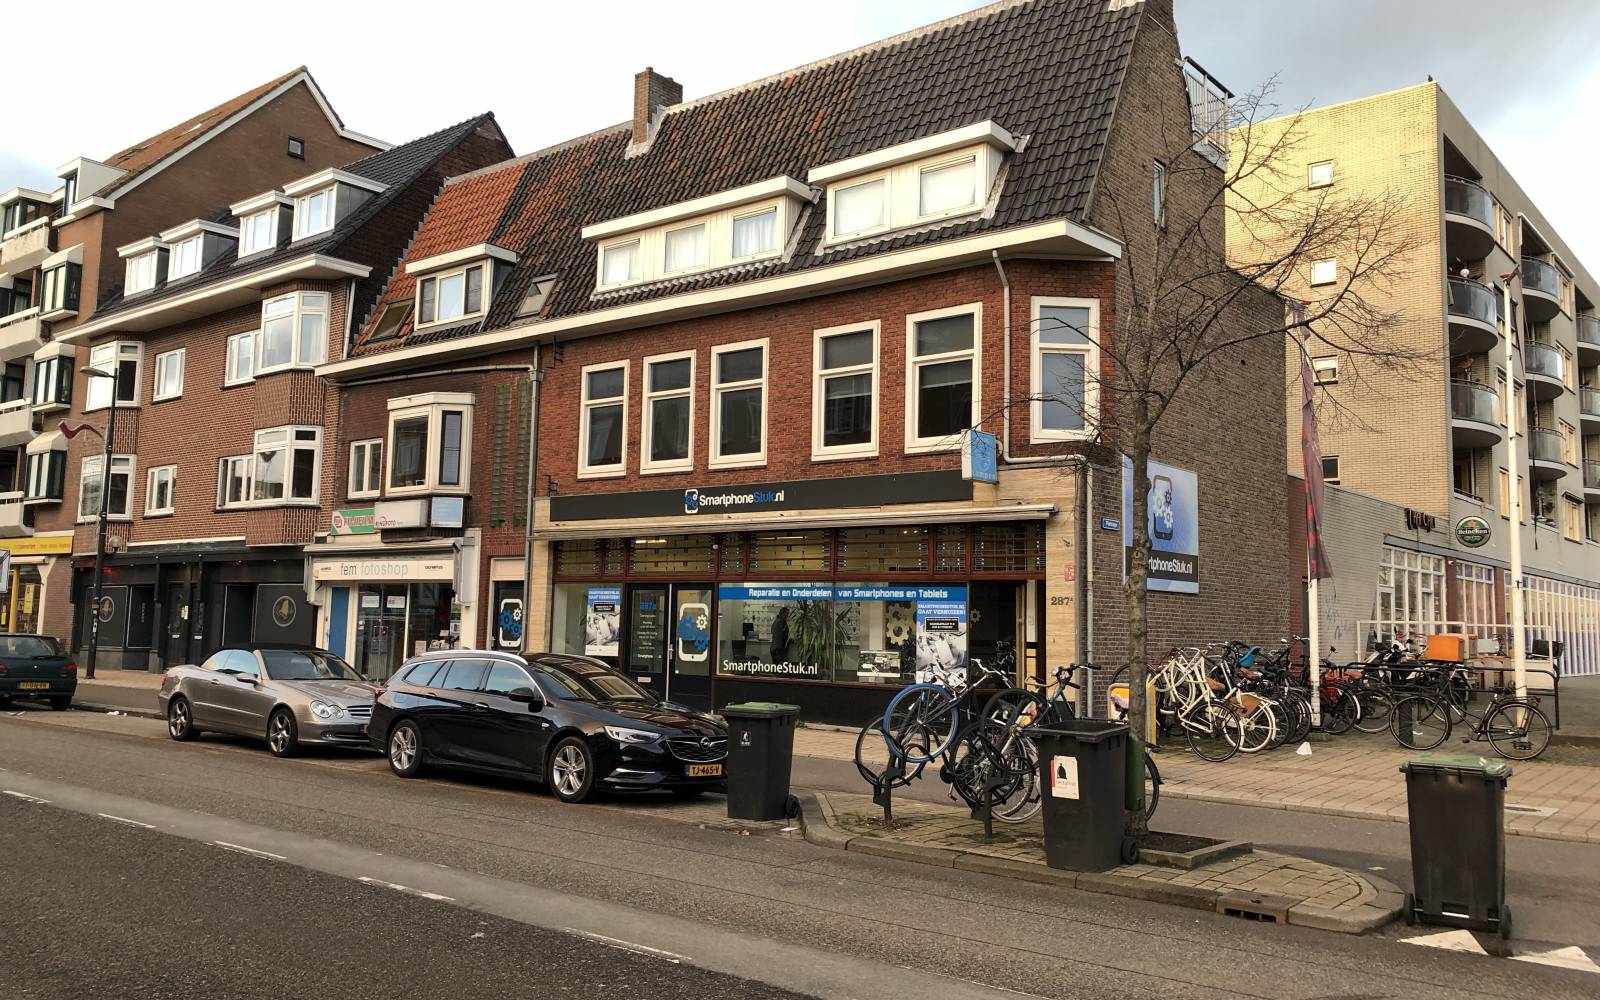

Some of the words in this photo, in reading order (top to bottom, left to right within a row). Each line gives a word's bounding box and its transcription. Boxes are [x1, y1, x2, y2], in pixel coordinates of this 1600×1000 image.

[700, 490, 785, 508] SmartphoneStuk.nl
[1458, 527, 1488, 535] Heineken
[340, 563, 357, 576] fem
[359, 562, 409, 577] fotoshop
[748, 588, 780, 598] Reparatie
[792, 588, 832, 597] Onderdelen
[838, 590, 853, 598] van
[854, 588, 905, 600] Smartphones
[906, 590, 917, 598] en
[919, 589, 949, 599] Tablets
[723, 659, 818, 675] SmartphoneStuk.nl
[692, 765, 720, 776] TJ-465-V
